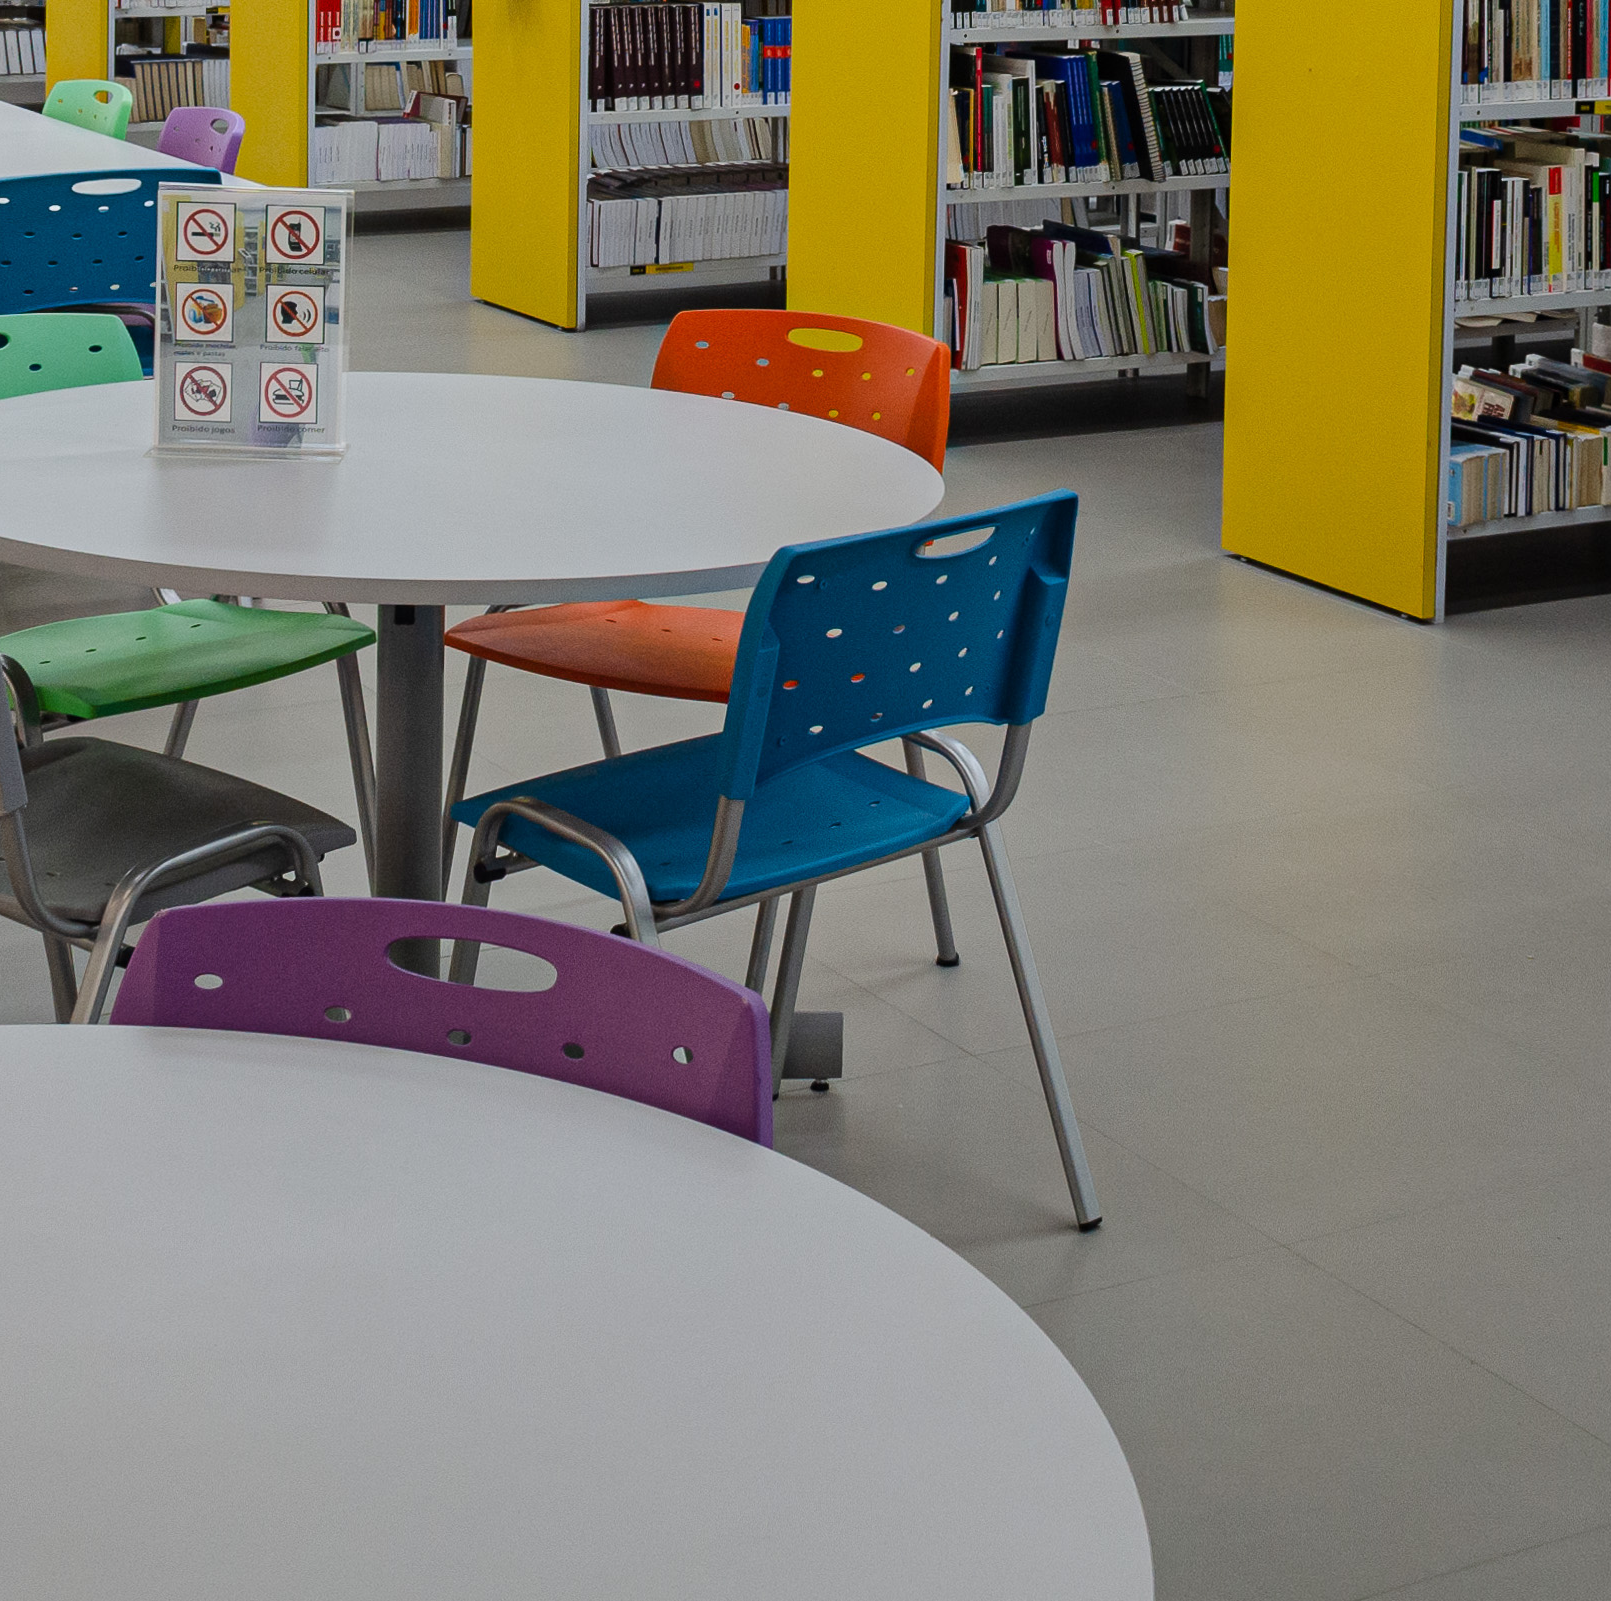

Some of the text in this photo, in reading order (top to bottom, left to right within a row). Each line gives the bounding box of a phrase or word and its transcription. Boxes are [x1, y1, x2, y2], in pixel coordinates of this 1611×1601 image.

[259, 266, 298, 276] Proibido
[259, 343, 293, 352] Proibido
[172, 424, 236, 434] Proibido jogos
[257, 424, 325, 434] Proibido comer
